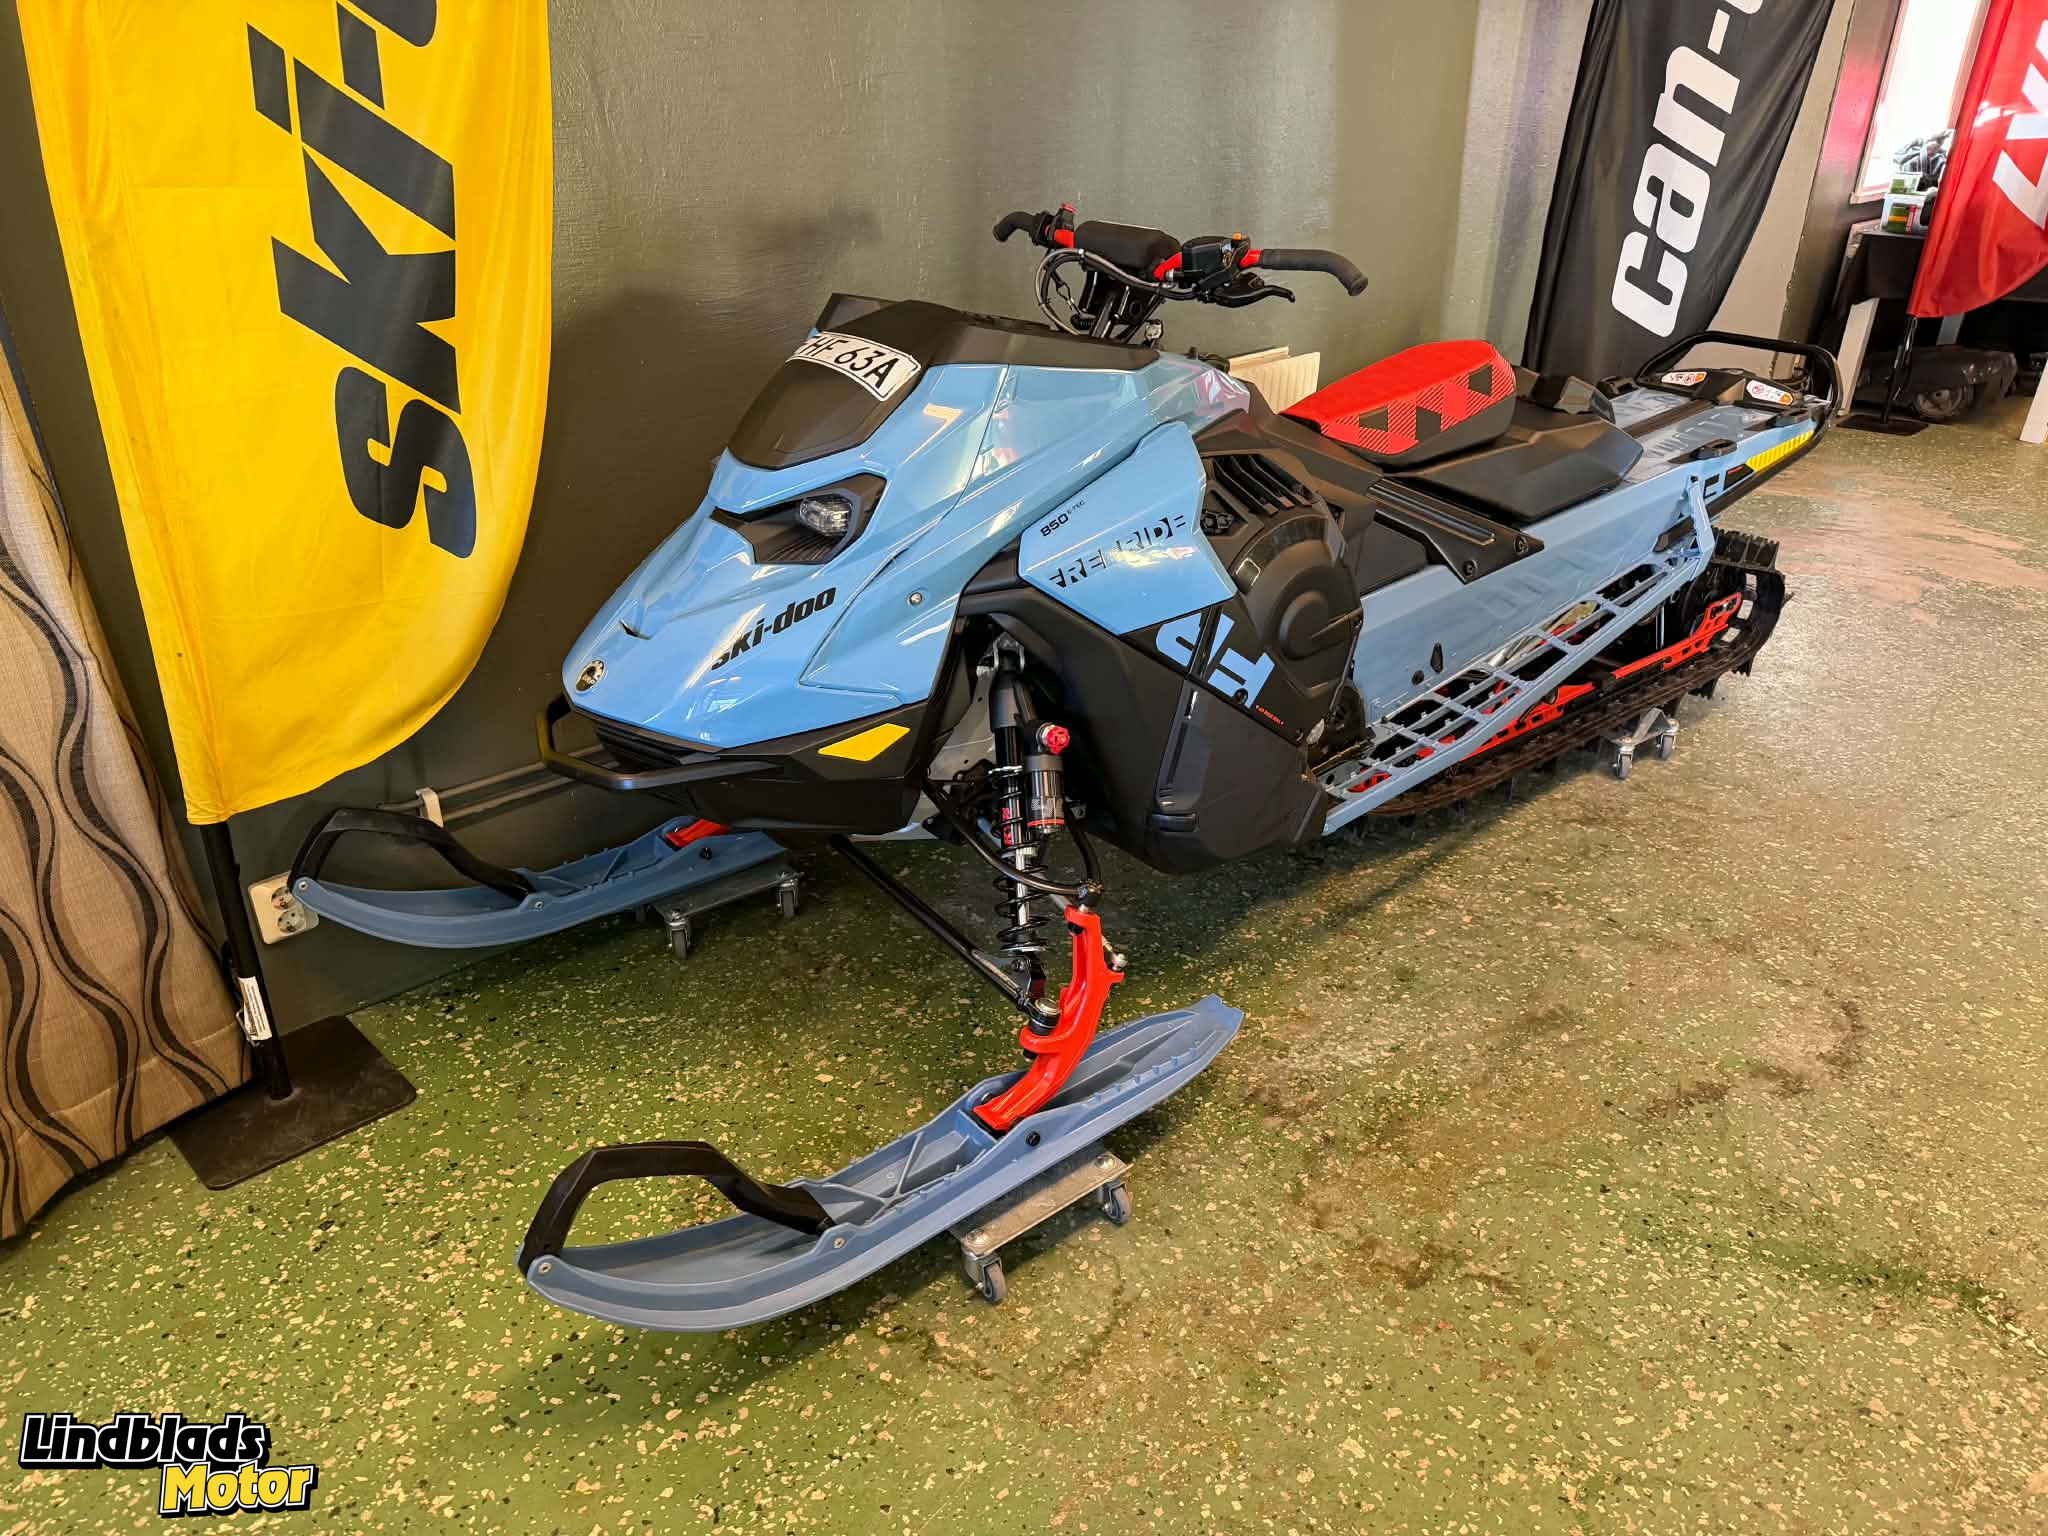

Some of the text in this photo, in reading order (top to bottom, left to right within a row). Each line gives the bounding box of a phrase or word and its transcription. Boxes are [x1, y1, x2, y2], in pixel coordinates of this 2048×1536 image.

[1612, 0, 1763, 338] can-
[246, 0, 477, 559] ski-
[834, 346, 900, 389] 63A
[1040, 513, 1070, 537] 850
[711, 586, 837, 671] ski-doo
